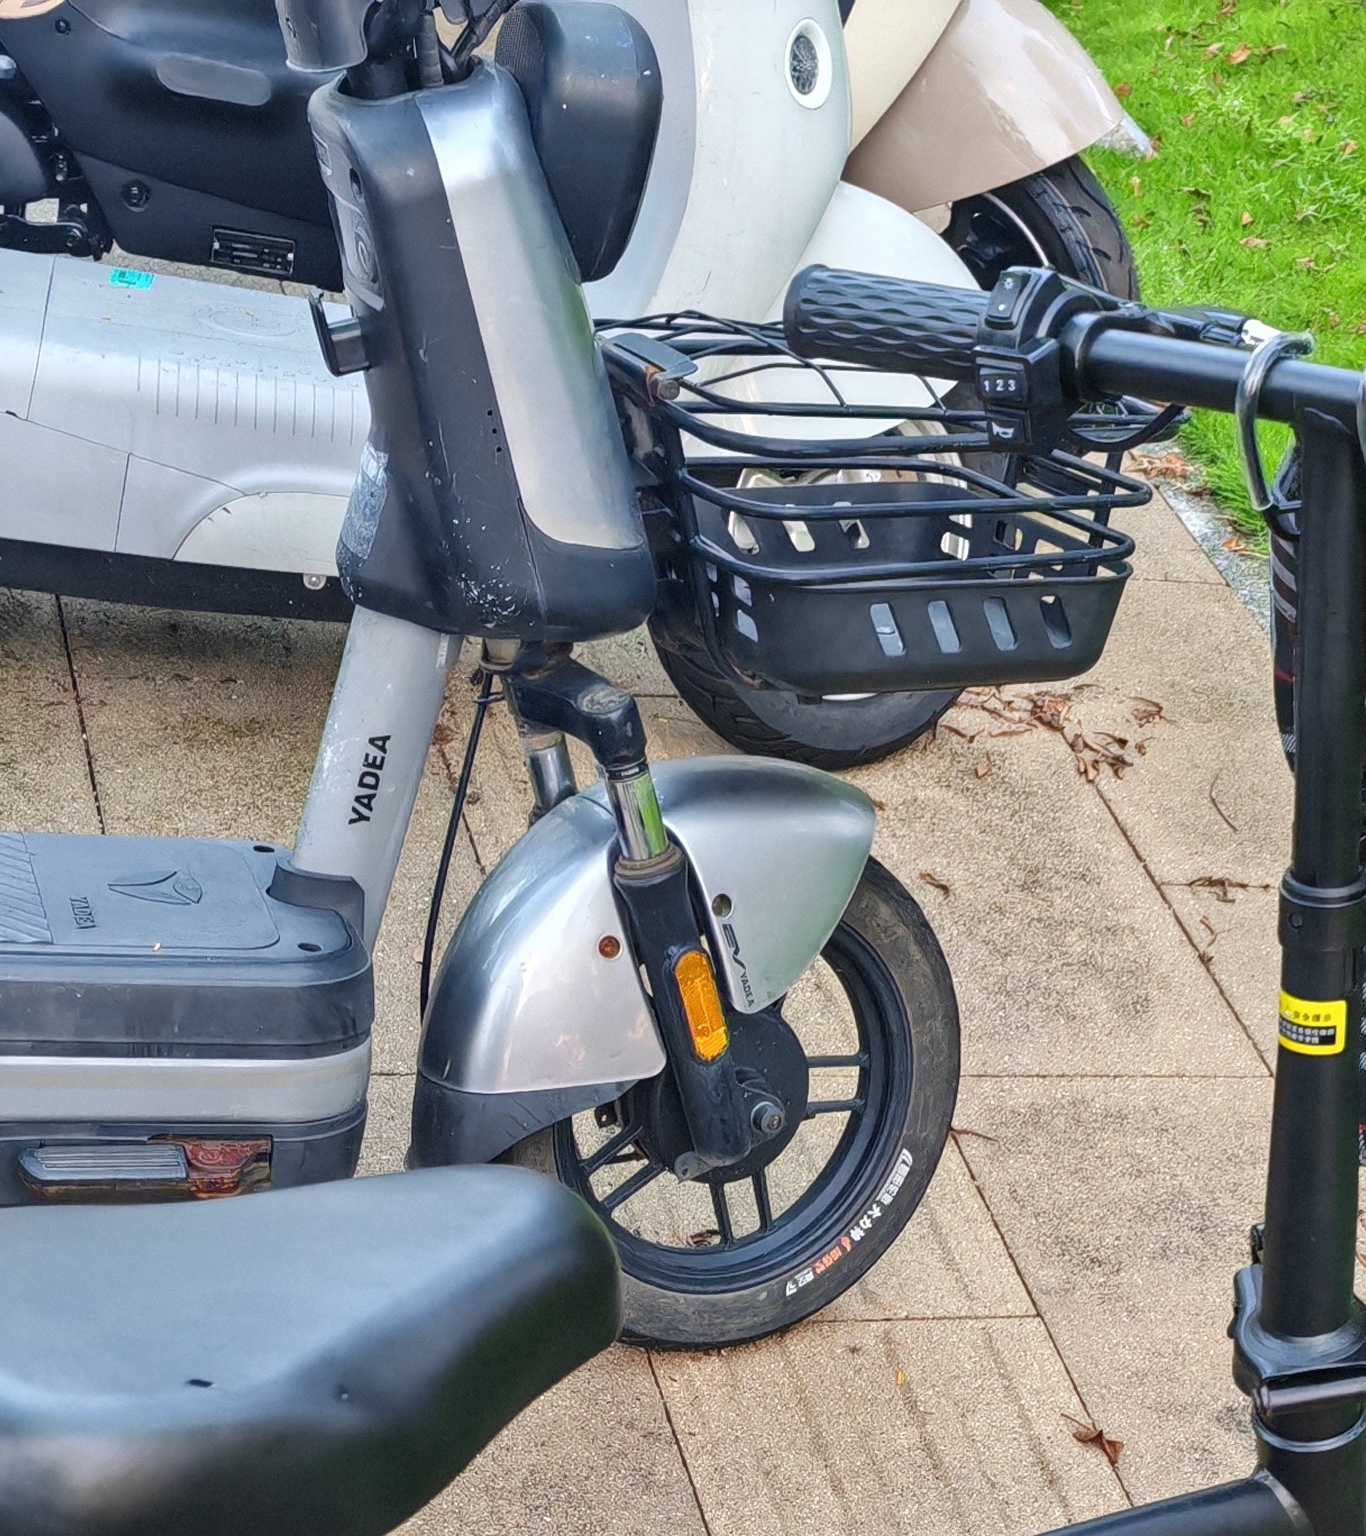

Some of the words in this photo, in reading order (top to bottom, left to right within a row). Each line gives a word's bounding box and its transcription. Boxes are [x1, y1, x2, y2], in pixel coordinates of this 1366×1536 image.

[348, 734, 391, 825] YADEA
[740, 971, 755, 1008] YADEA
[850, 1203, 882, 1241] 大力神
